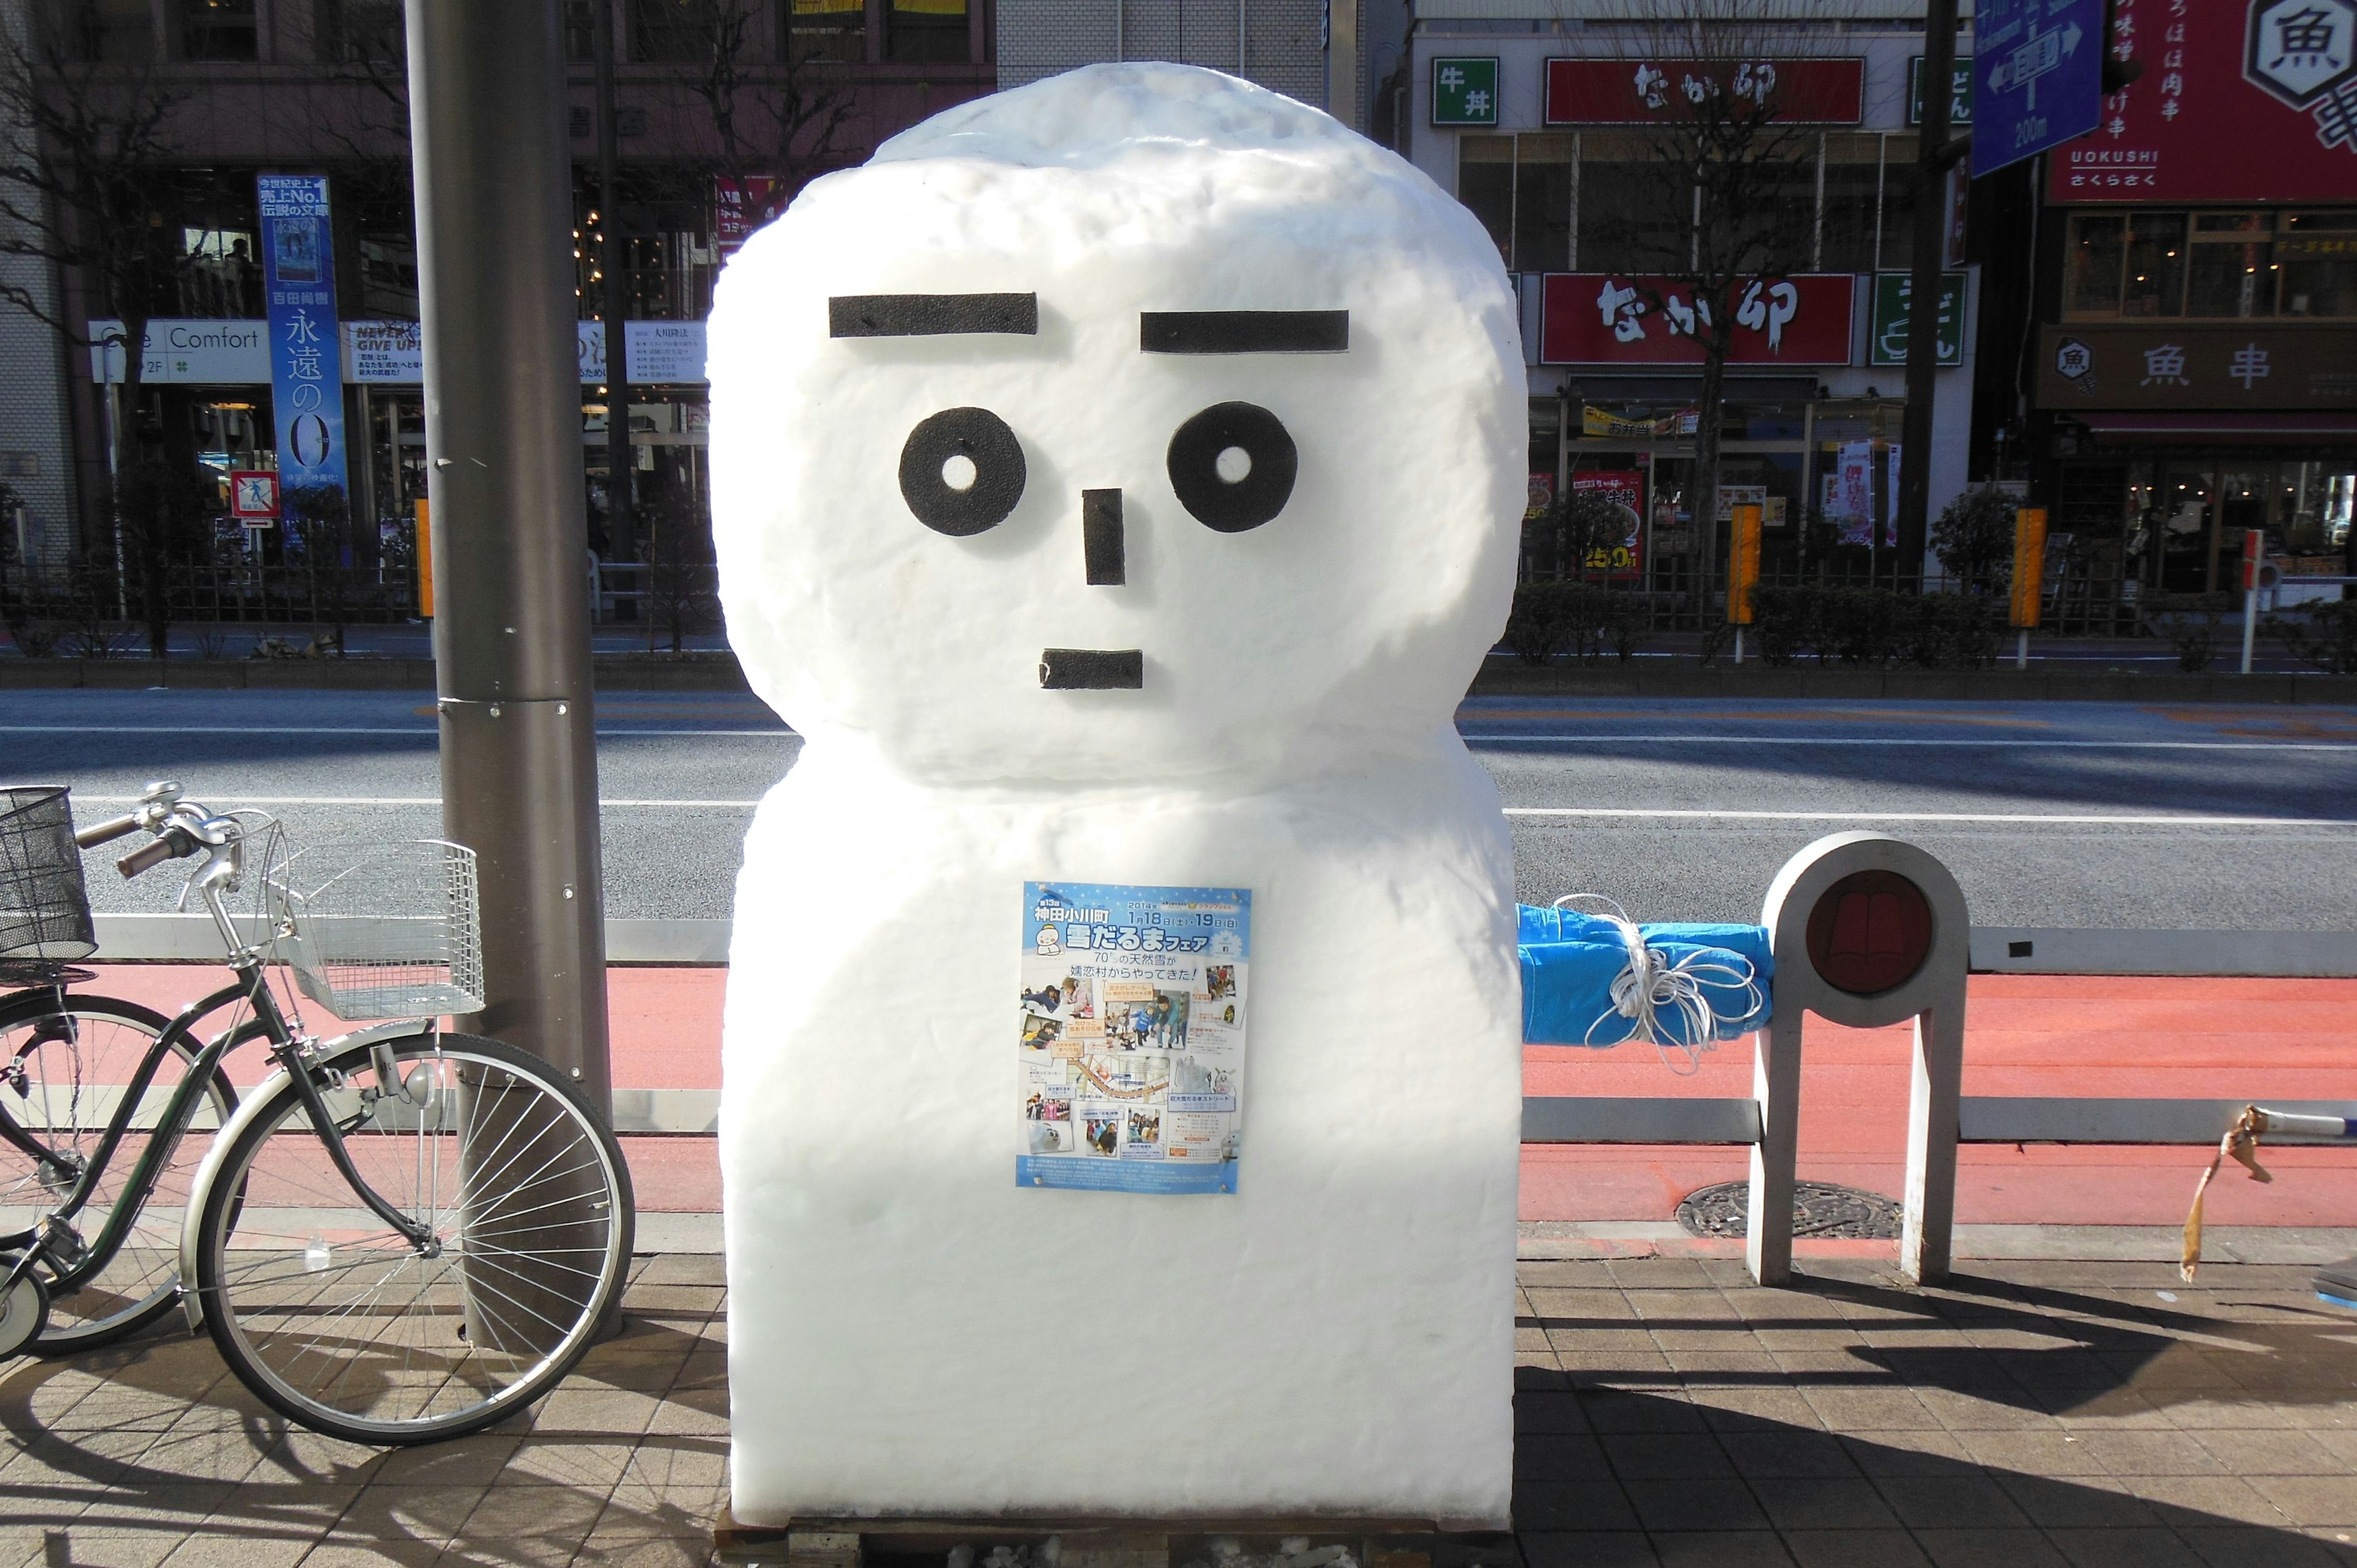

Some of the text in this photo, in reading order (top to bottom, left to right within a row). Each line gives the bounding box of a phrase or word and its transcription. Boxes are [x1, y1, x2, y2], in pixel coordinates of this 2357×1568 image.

[2269, 6, 2339, 69] 魚
[1440, 66, 1490, 116] 牛丼
[1634, 63, 1776, 110] なか卯
[2015, 116, 2048, 150] 200m
[2071, 150, 2159, 163] UOKUSHI
[260, 179, 312, 188] 今世紀史上
[2071, 174, 2156, 186] さくらさく
[262, 204, 329, 217] 伝説の文庫
[722, 222, 753, 233] コミッ
[273, 292, 328, 305] 百田尚樹
[1597, 280, 1798, 355] なか卯
[171, 326, 258, 349] Comfort
[357, 327, 404, 339] NEVER
[357, 340, 421, 351] GIVE UP!
[147, 361, 162, 373] 2F
[1609, 422, 1649, 435] お弁当
[1034, 907, 1110, 924] 神田小川町
[1066, 923, 1209, 952] 雪だるまフェア
